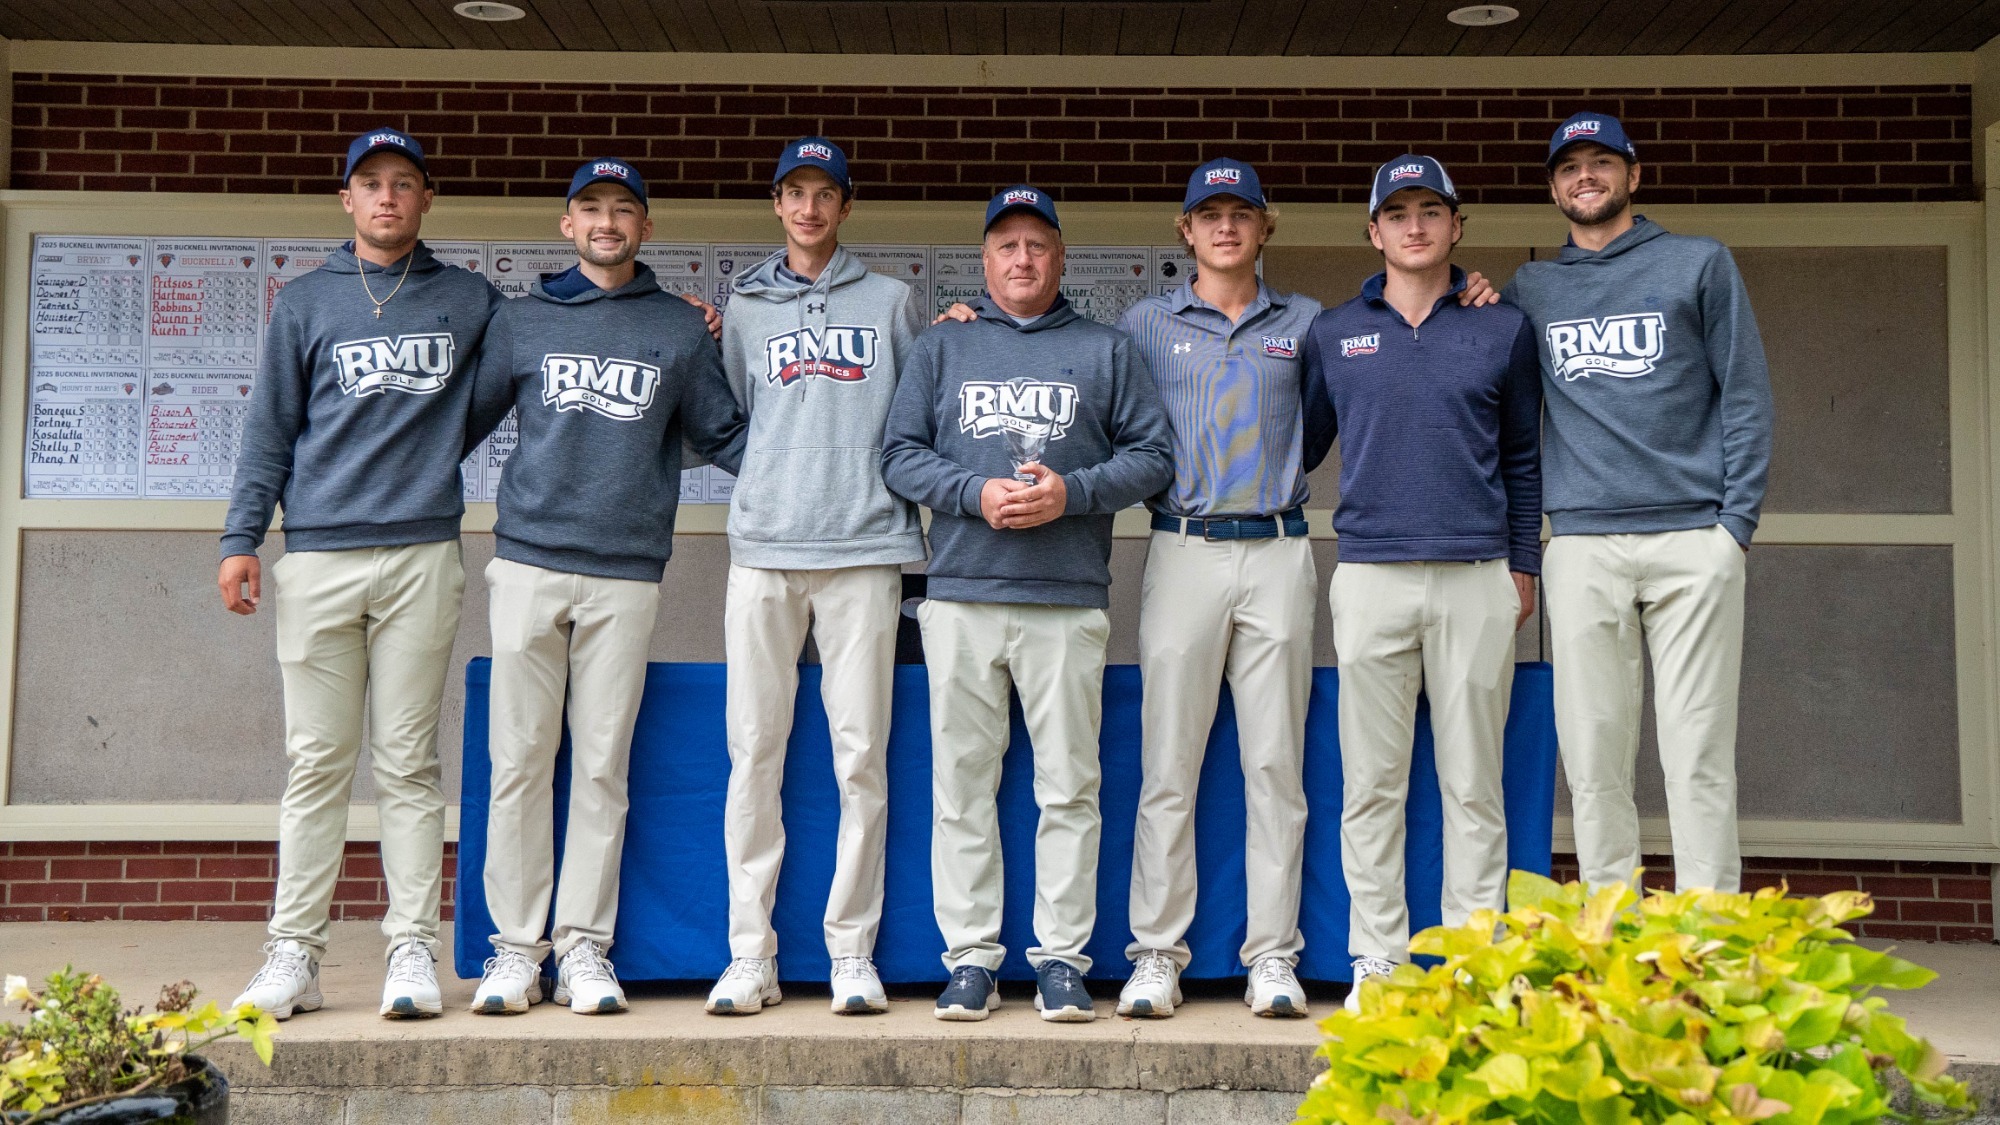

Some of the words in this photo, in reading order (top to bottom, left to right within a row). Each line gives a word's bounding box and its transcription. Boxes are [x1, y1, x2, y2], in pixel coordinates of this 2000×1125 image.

[1563, 120, 1600, 140] RMU
[368, 134, 406, 147] RMU
[798, 143, 832, 160] RMU
[592, 162, 628, 178] RMU
[1389, 164, 1424, 182] RMU
[1205, 168, 1241, 184] RMU
[1003, 190, 1038, 204] RMU
[96, 242, 142, 250] INVITATIONAL
[77, 256, 112, 264] BRYANT
[182, 258, 226, 266] BUCKNELL
[228, 258, 235, 266] A
[296, 258, 326, 267] BUCKN
[527, 262, 564, 270] COLGATE
[872, 265, 898, 273] SALLE
[968, 266, 978, 274] LE
[1073, 266, 1126, 274] MANHATTAN
[80, 276, 88, 286] D
[198, 279, 204, 288] P
[70, 288, 80, 298] M
[152, 288, 196, 300] Hartman
[1062, 286, 1089, 296] lkner
[72, 300, 79, 310] S
[152, 300, 193, 312] Robbins
[196, 302, 202, 312] J
[1084, 299, 1090, 308] A
[78, 311, 88, 322] T
[152, 312, 188, 325] Quinn
[194, 314, 202, 324] H
[74, 322, 83, 334] C
[151, 324, 186, 336] Kuehn
[193, 326, 200, 336] T
[1262, 336, 1296, 351] RMU
[1343, 333, 1380, 354] RMU
[1550, 318, 1659, 369] RMU
[769, 329, 875, 378] RMU
[338, 338, 450, 388] RMU
[1586, 358, 1618, 368] GOLF
[206, 372, 253, 380] INVITATIONAL
[382, 374, 414, 385] GOLF
[546, 358, 656, 405] RMU
[192, 386, 218, 394] RIDER
[582, 392, 612, 408] GOLF
[964, 386, 1074, 425] RMU
[80, 406, 85, 416] S
[184, 406, 192, 416] A
[32, 416, 71, 429] Fortney
[76, 418, 83, 428] T
[189, 418, 198, 428] R
[1002, 418, 1032, 430] GOLF
[32, 440, 68, 454] Shelly
[74, 442, 82, 452] D
[169, 442, 178, 452] S
[70, 454, 79, 464] N
[148, 454, 178, 464] Jones
[180, 454, 190, 464] R
